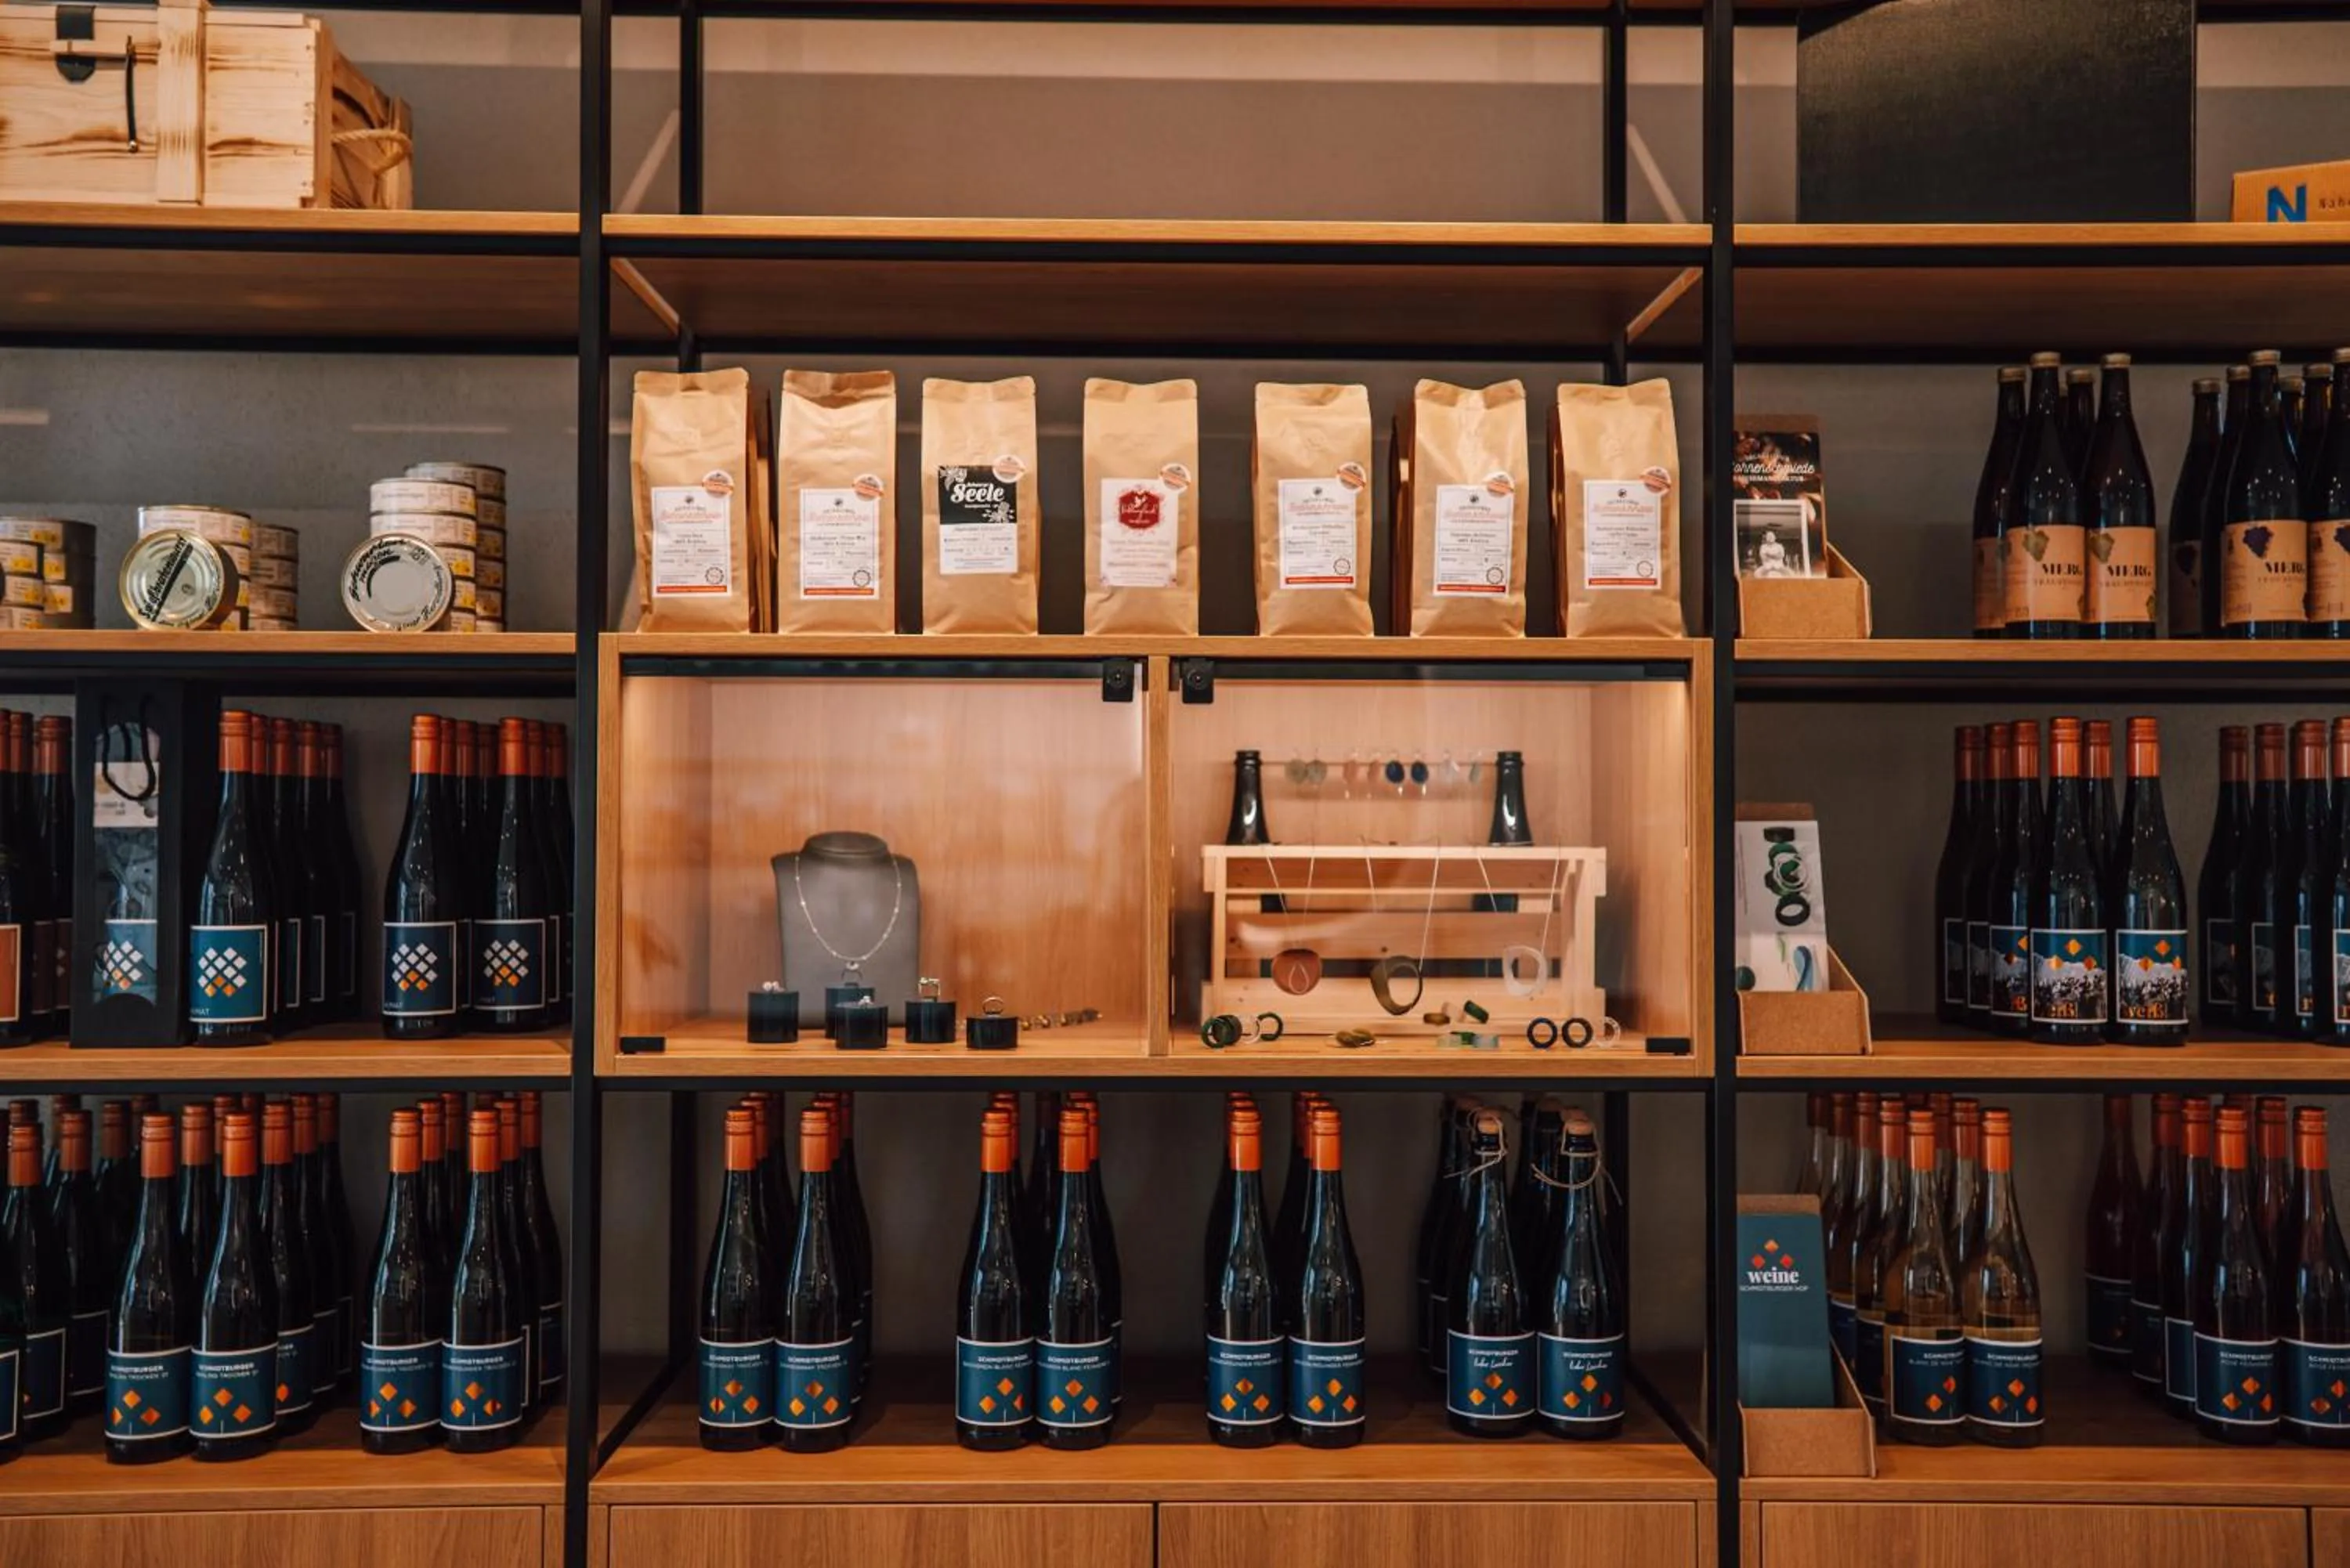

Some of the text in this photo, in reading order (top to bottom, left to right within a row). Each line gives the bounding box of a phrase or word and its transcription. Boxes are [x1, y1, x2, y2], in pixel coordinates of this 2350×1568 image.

[2268, 183, 2307, 222] N
[1733, 461, 1815, 474] ohnenschmiede
[950, 482, 1005, 504] Seele
[1747, 1266, 1799, 1284] weine
